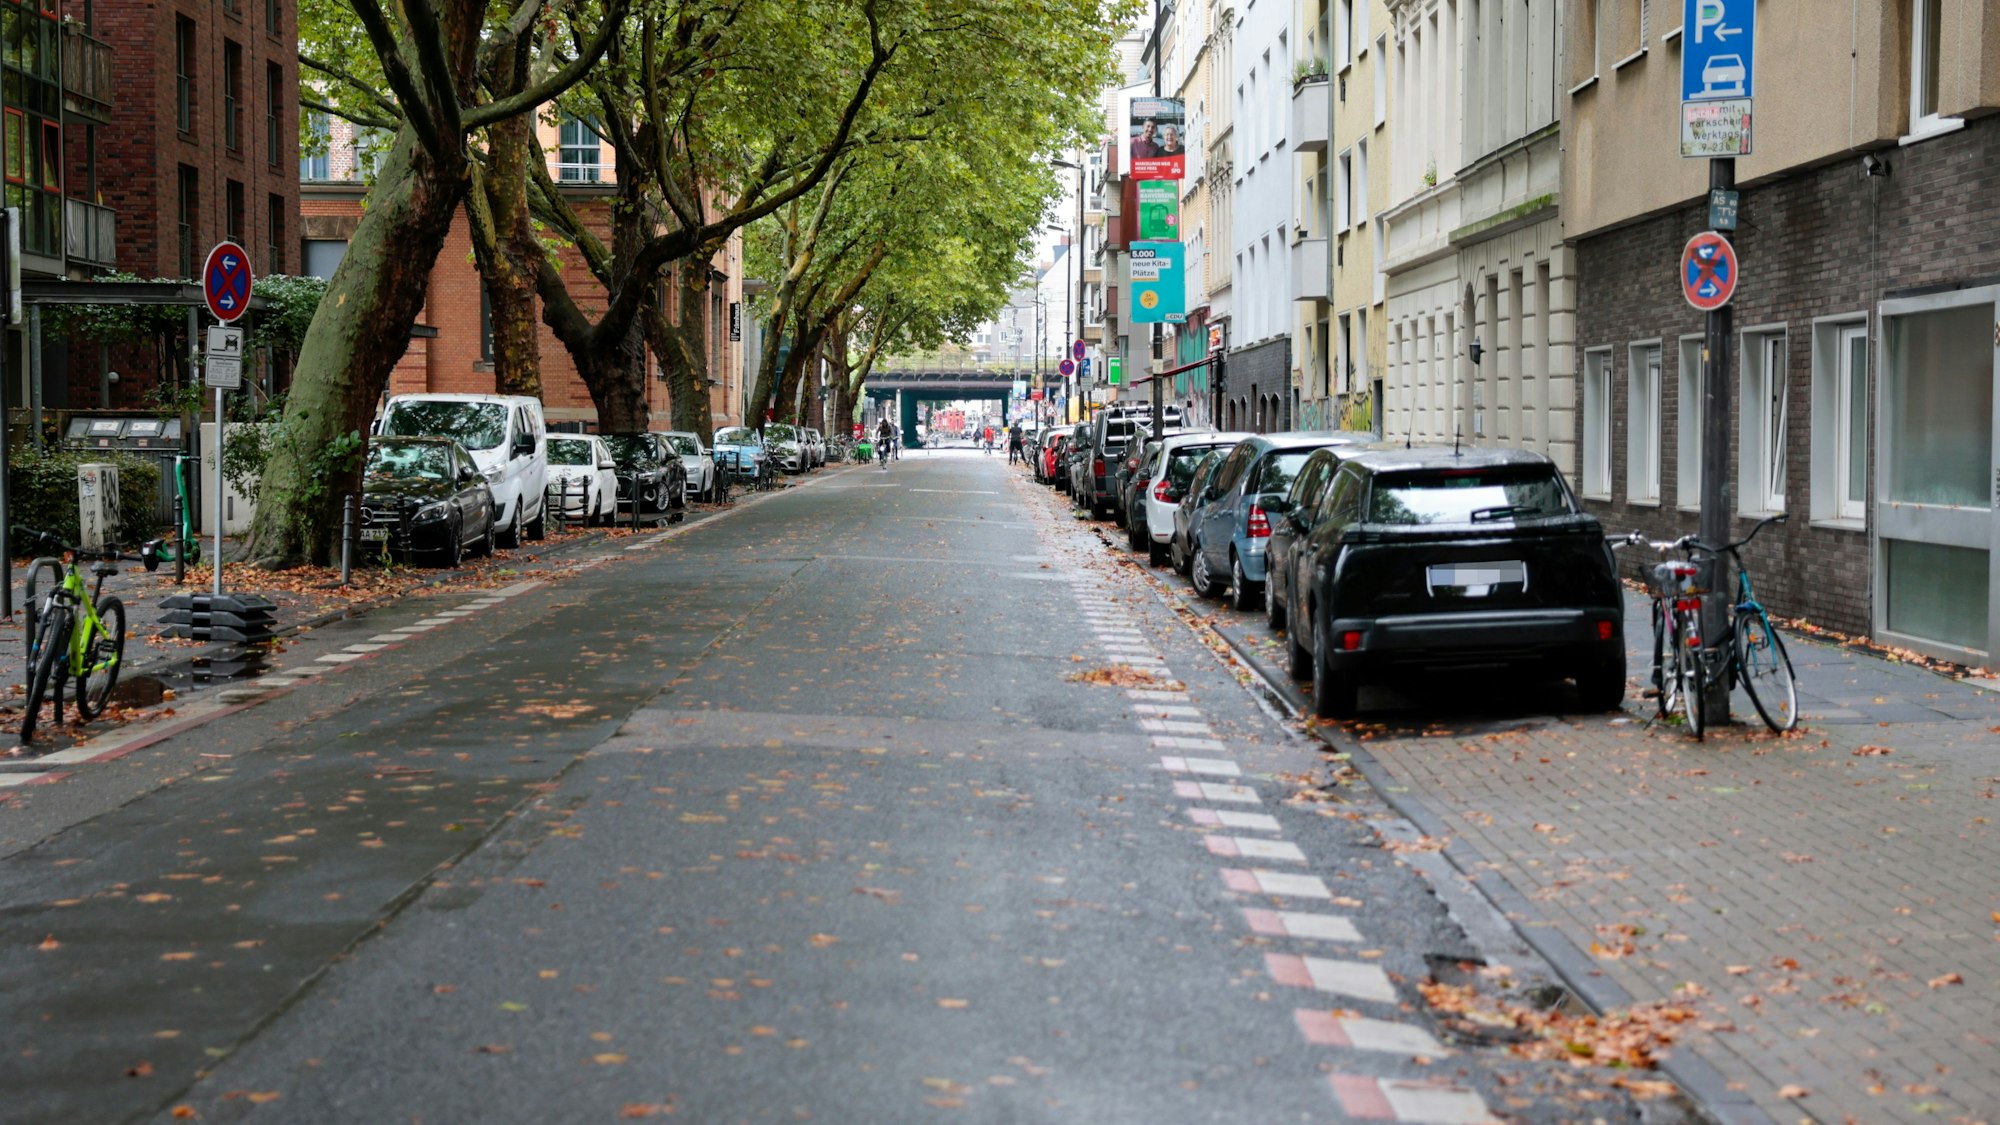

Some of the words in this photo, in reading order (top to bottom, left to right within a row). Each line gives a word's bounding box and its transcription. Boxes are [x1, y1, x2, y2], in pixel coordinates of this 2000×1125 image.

[1695, 0, 1725, 44] P
[1719, 104, 1735, 113] mit
[1713, 196, 1725, 205] AS
[1132, 250, 1154, 258] 5.000
